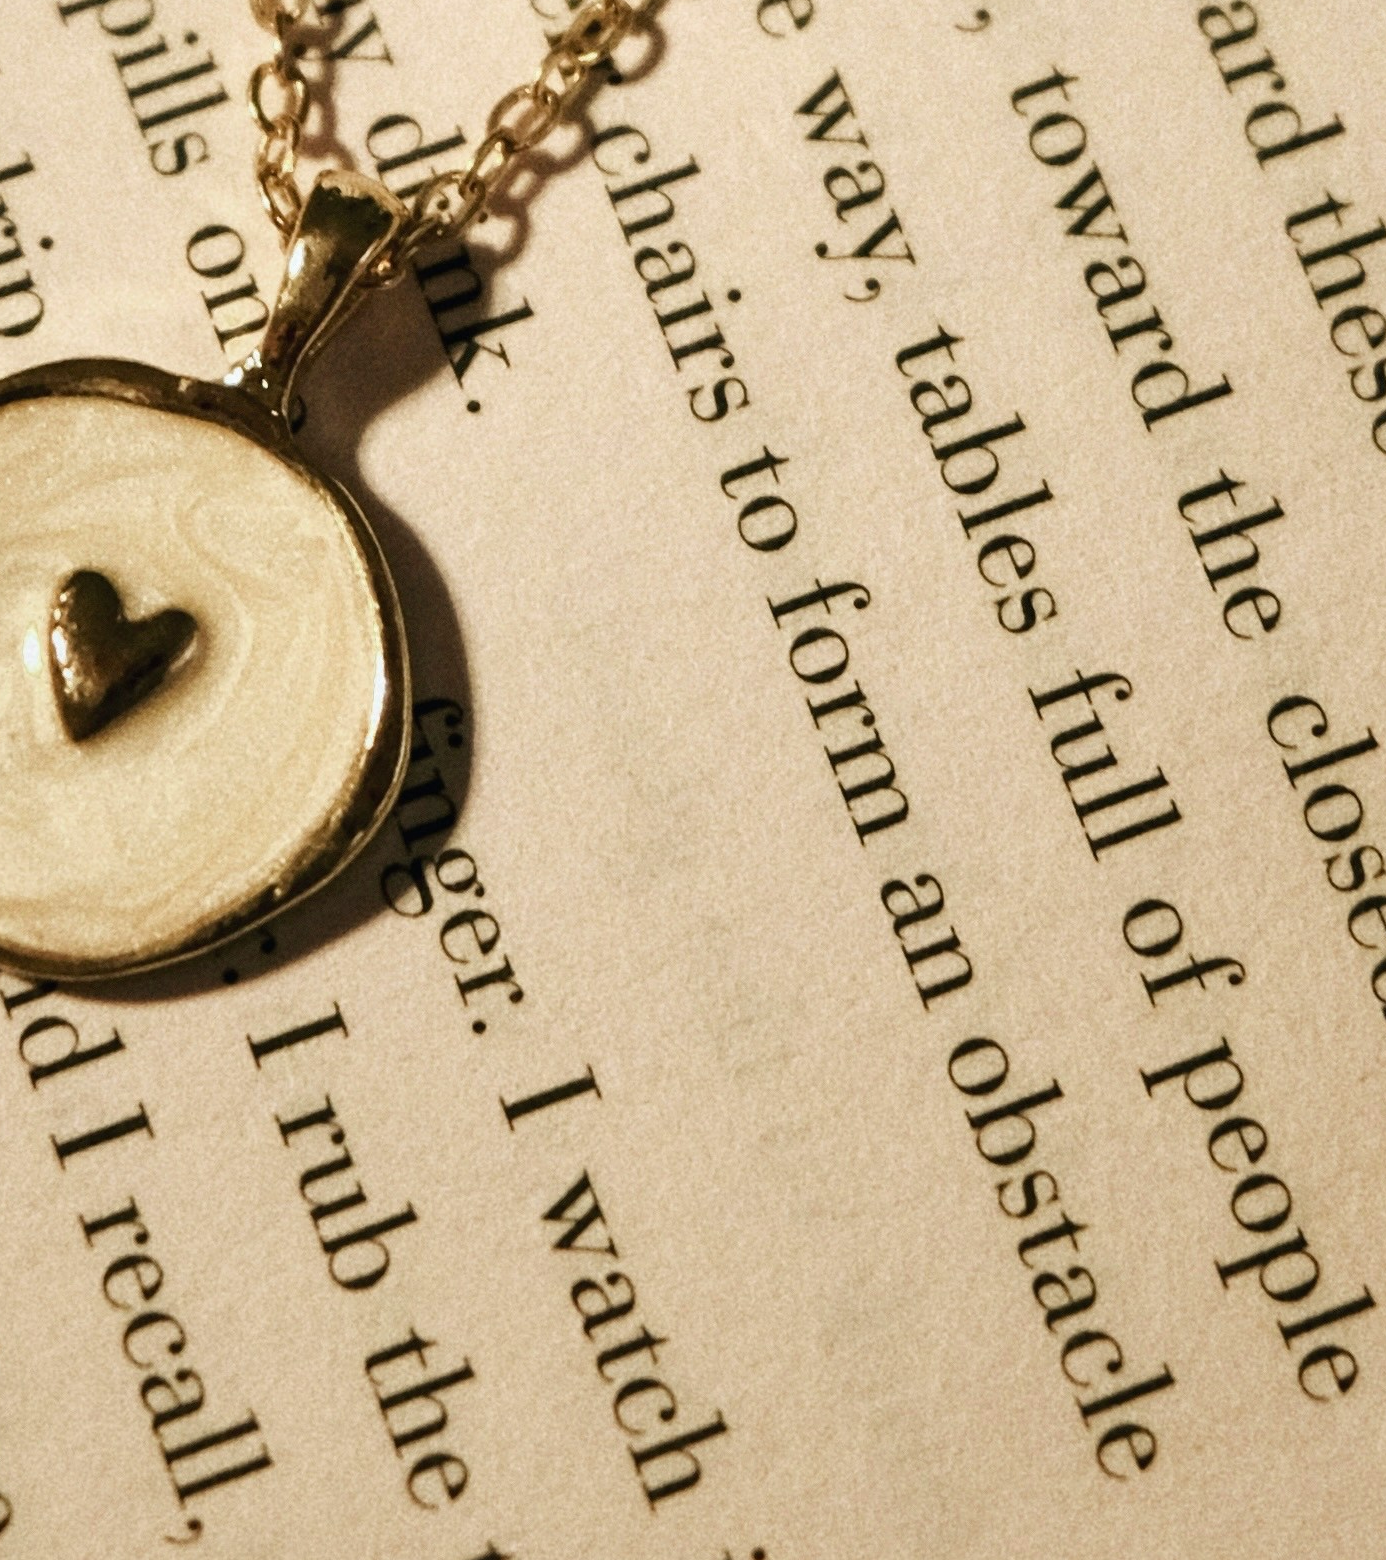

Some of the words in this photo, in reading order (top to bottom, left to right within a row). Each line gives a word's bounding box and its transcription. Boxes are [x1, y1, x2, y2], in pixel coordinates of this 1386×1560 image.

[795, 69, 918, 304] way,
[176, 217, 283, 357] on
[1009, 68, 1235, 433] toward
[1176, 469, 1286, 641] the
[894, 325, 1059, 636] tables
[579, 115, 759, 429] chairs
[718, 445, 799, 554] to
[766, 578, 911, 847] form
[879, 872, 975, 1011] an
[947, 1035, 1178, 1480] obstacle
[1027, 669, 1184, 863] full
[245, 1002, 350, 1070] I
[1121, 897, 1247, 1008] of
[50, 1102, 155, 1169] I
[274, 1095, 420, 1294] rub
[499, 1065, 603, 1131] I
[1138, 1036, 1378, 1403] people
[78, 1197, 275, 1554] recall,
[363, 1327, 476, 1509] the
[541, 1170, 730, 1513] watch
